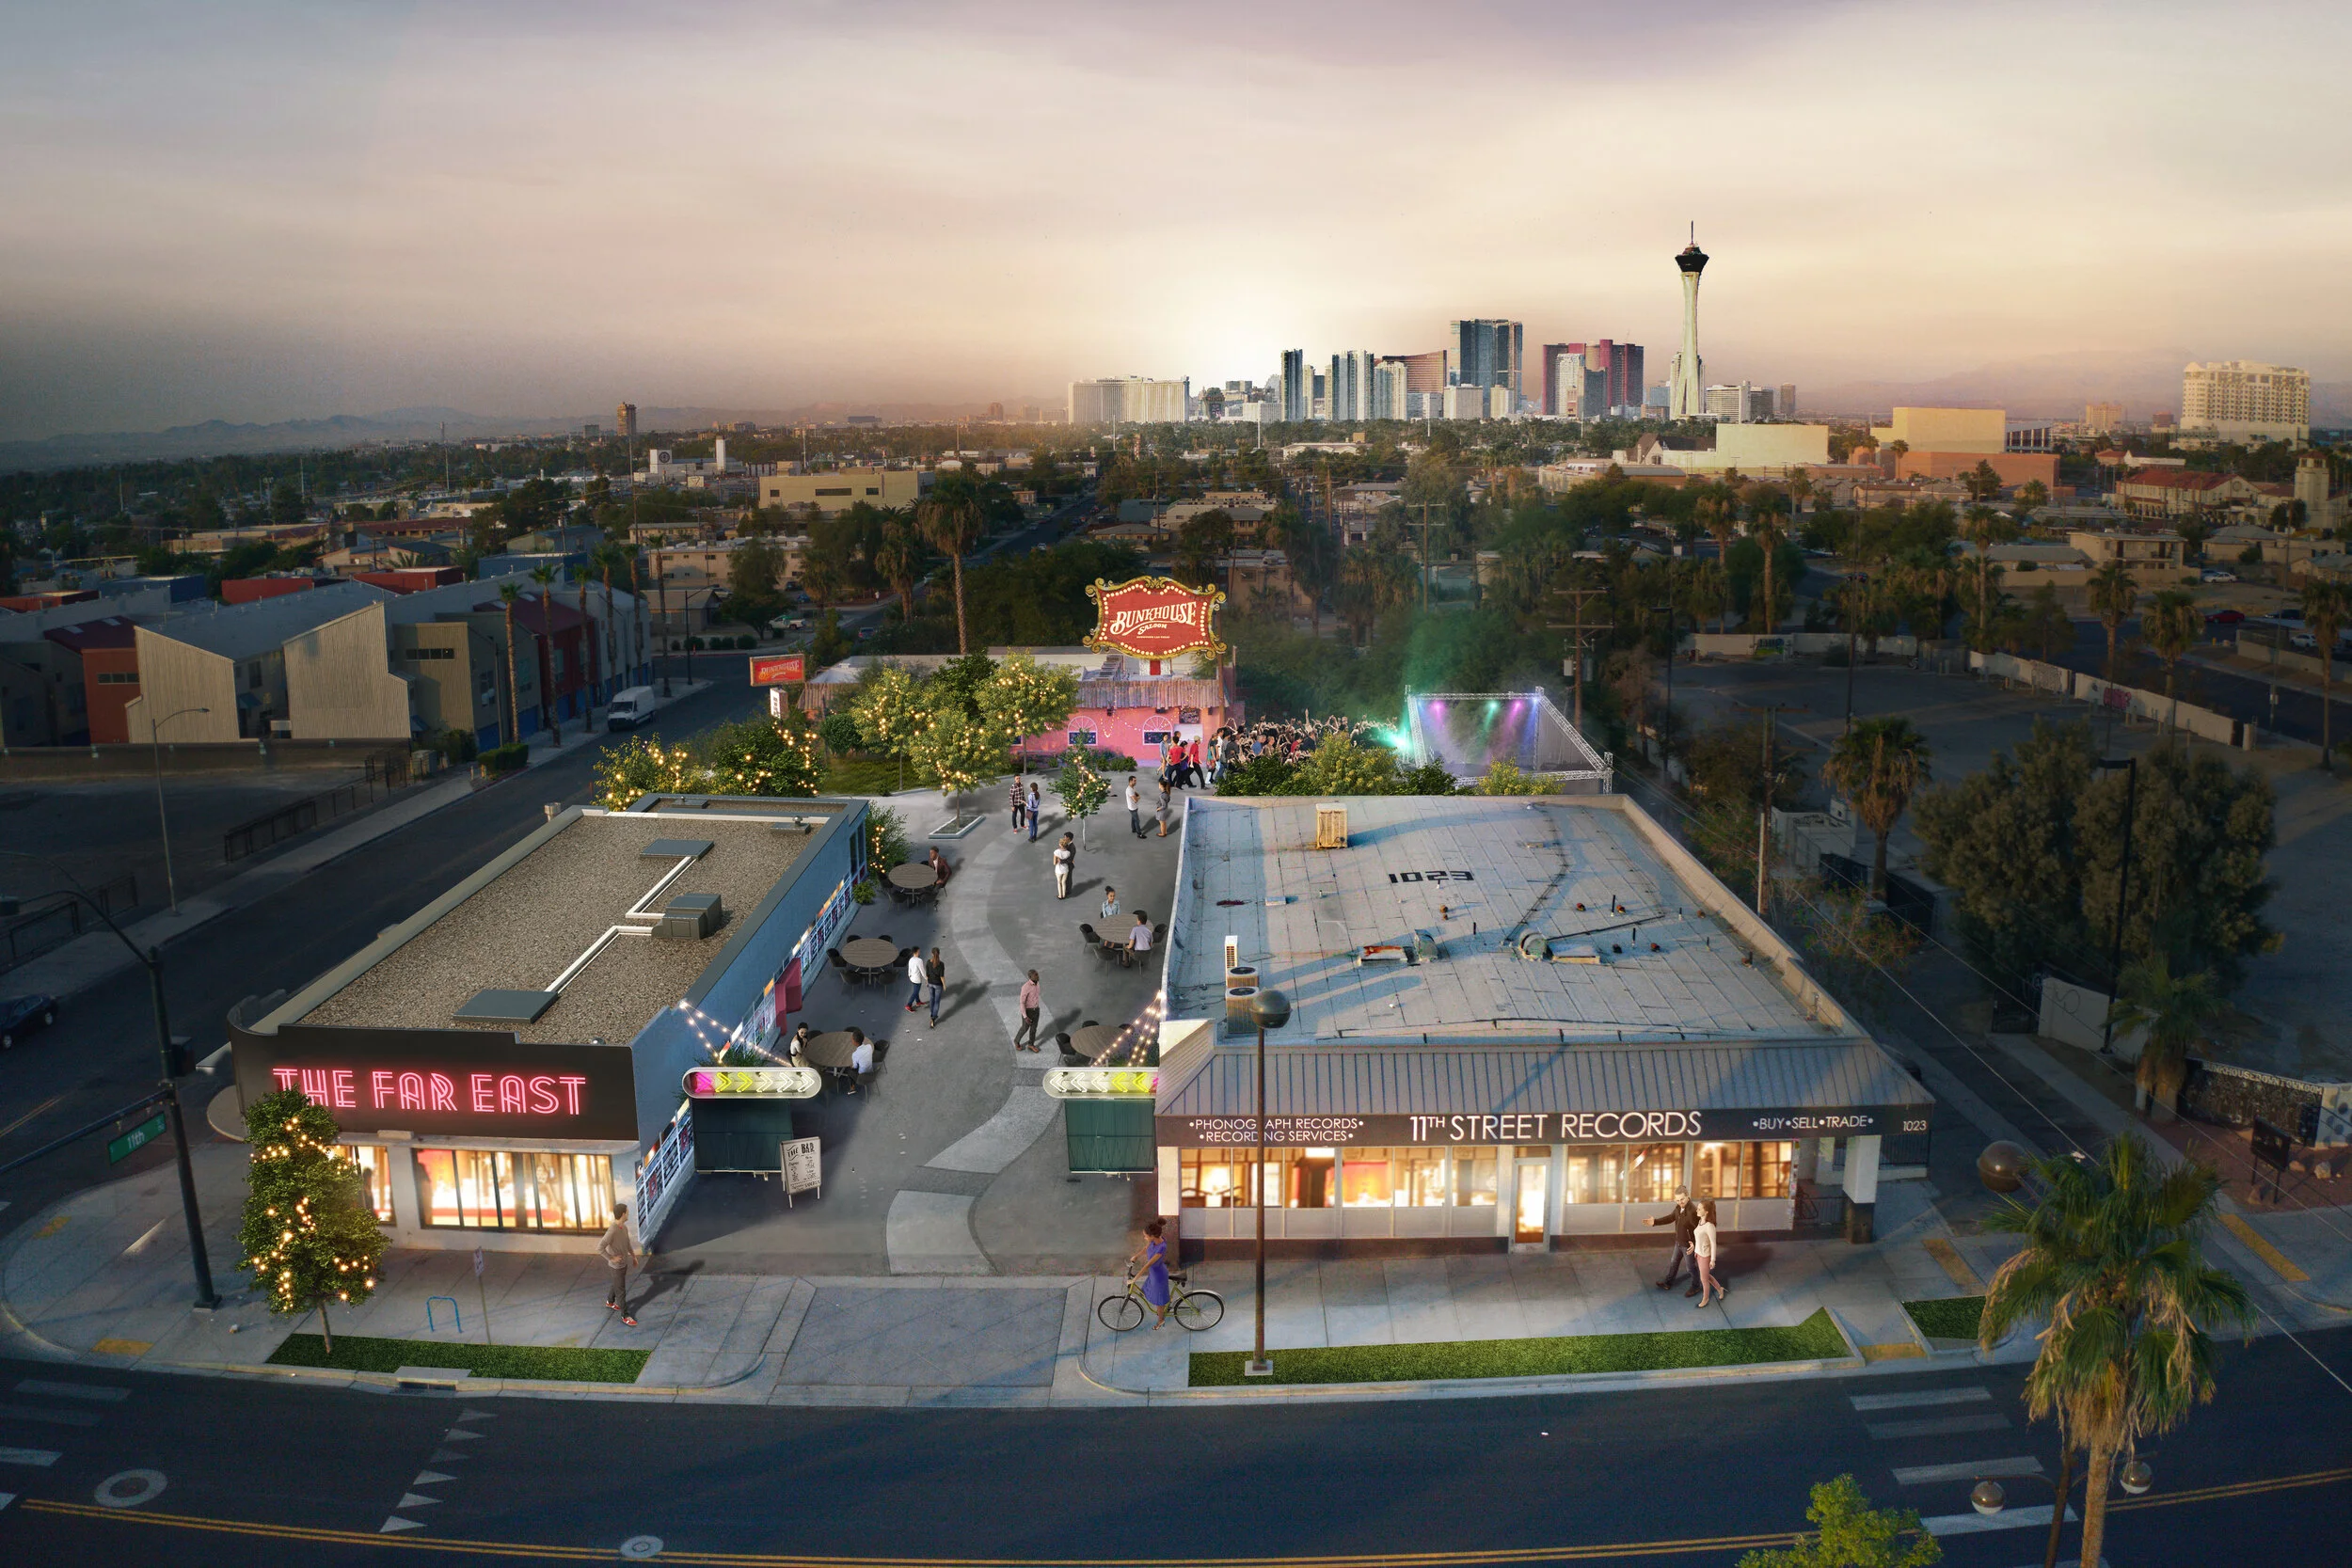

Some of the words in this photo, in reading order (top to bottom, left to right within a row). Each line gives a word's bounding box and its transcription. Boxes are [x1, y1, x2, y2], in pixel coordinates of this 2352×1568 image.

[1110, 601, 1197, 635] BUNKHOUSE
[1137, 624, 1167, 635] SALOON
[1389, 870, 1474, 883] 1023
[273, 1068, 356, 1108] THE
[373, 1070, 458, 1111] FAR
[471, 1073, 586, 1116] EAST
[1196, 1118, 1291, 1130] PHONOGAPH
[1295, 1117, 1358, 1130] RECORDS
[1410, 1115, 1445, 1141] 11TH
[1450, 1114, 1548, 1141] STREET
[1561, 1111, 1702, 1139] RECORDS
[1903, 1120, 1927, 1132] 1023
[127, 1131, 145, 1149] 11th
[1206, 1131, 1285, 1142] RECORDNG
[1289, 1131, 1347, 1142] SERVICES
[801, 1142, 815, 1154] BAR
